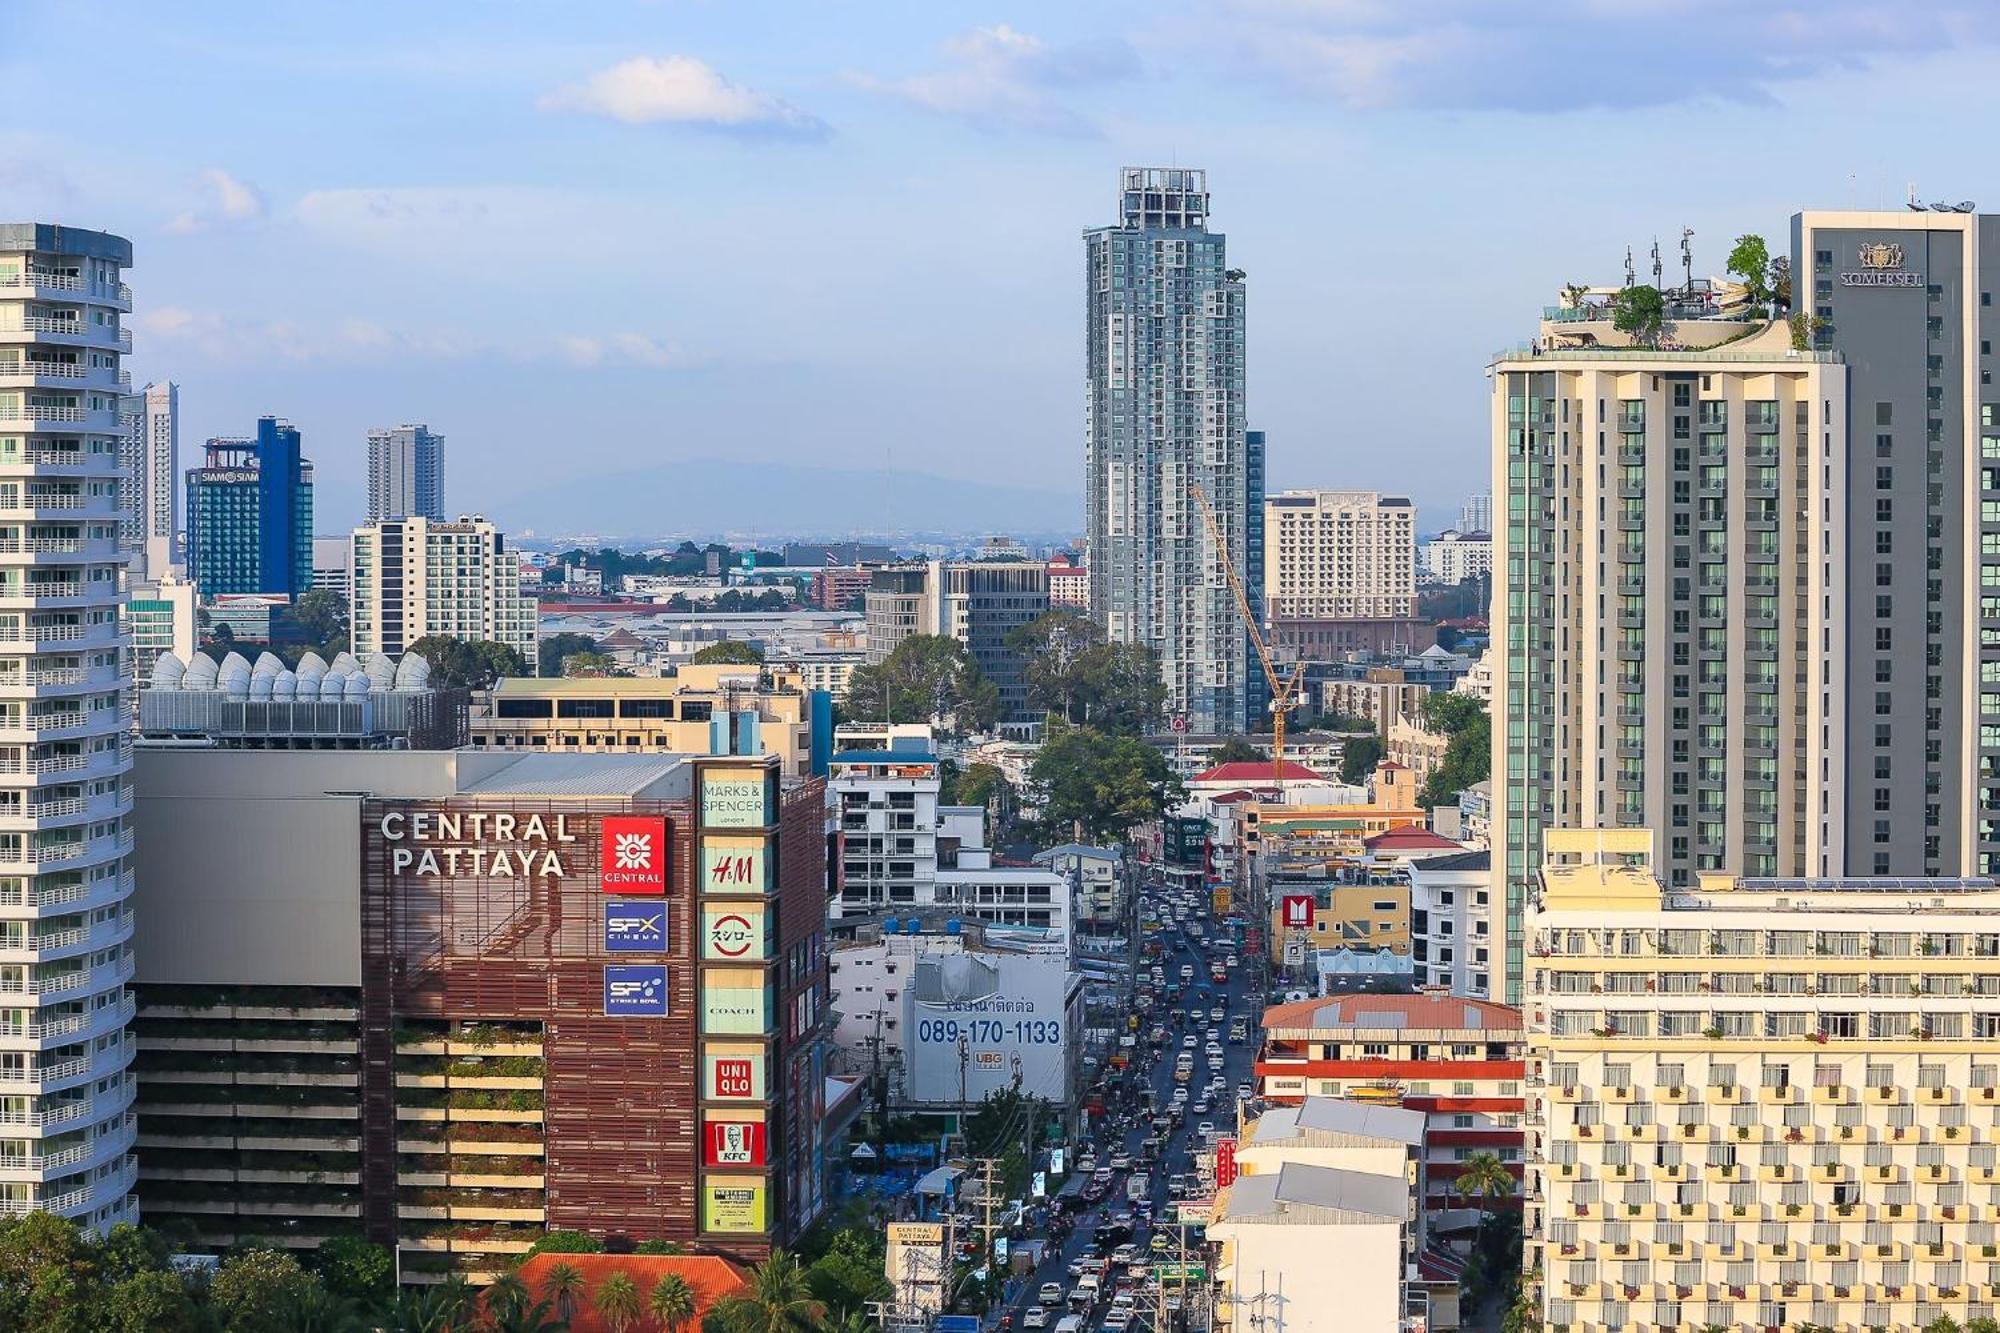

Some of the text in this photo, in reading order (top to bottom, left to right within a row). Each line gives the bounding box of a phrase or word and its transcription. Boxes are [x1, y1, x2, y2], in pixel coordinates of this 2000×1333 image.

[1841, 273, 1922, 285] SOMERSET
[704, 786, 760, 797] MARKS &
[702, 801, 763, 812] SPENCER
[381, 812, 576, 842] CENTRAL
[393, 849, 564, 877] PATTAYA
[712, 856, 753, 885] H&M
[604, 872, 662, 884] CENTRAL
[608, 914, 662, 933] SFX
[711, 930, 754, 941] スシロー
[610, 982, 642, 996] SF
[919, 1020, 1060, 1044] 089-170-1133
[721, 1065, 747, 1077] UNI
[721, 1079, 749, 1094] QLO
[723, 1152, 747, 1161] KFC
